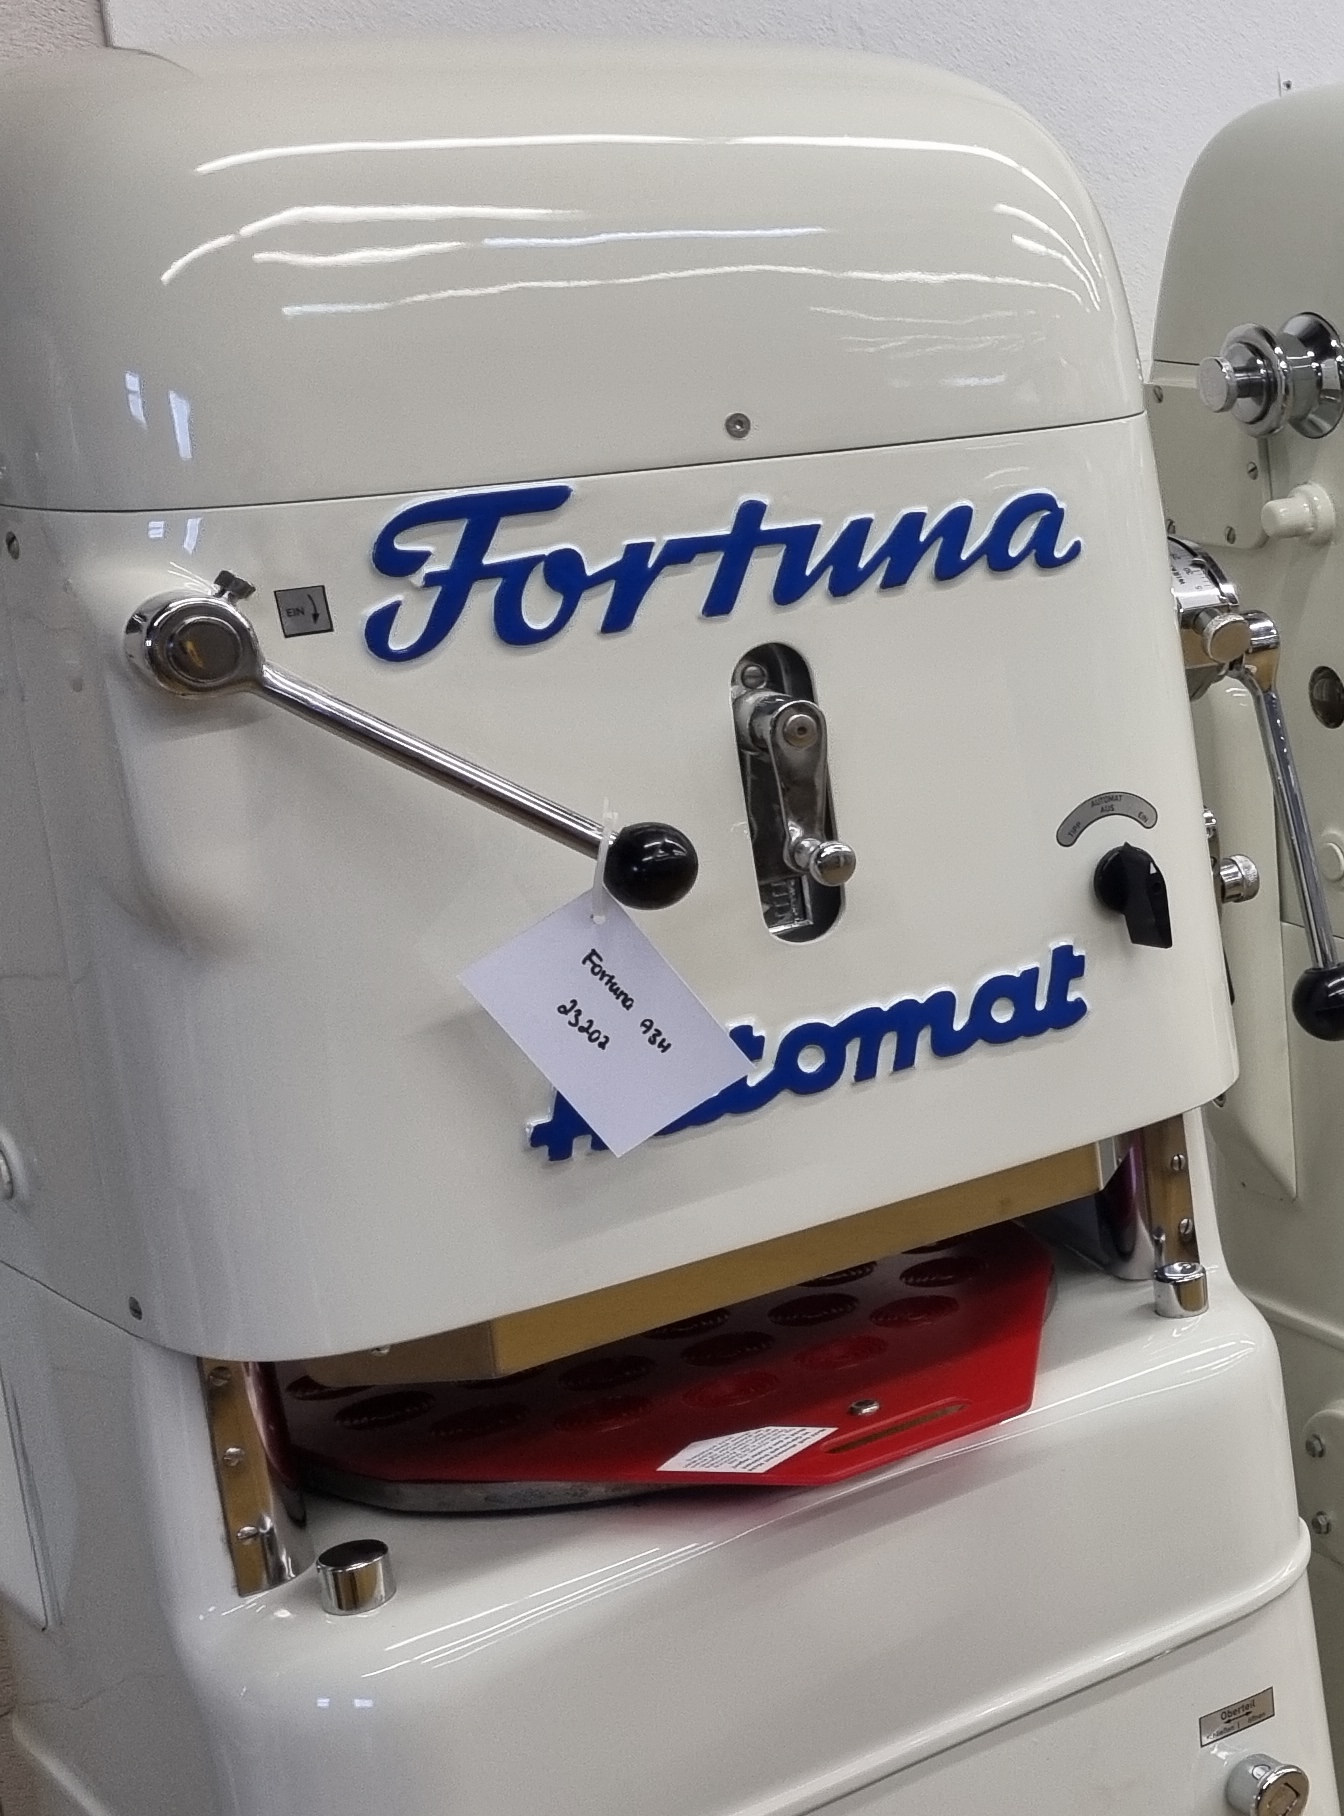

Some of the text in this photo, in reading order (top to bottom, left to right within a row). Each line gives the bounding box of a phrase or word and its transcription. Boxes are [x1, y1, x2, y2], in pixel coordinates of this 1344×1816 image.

[365, 485, 1081, 663] Fortuna
[285, 607, 305, 618] EIN
[1091, 794, 1123, 808] AUTOMAT
[1100, 804, 1115, 813] AUS
[581, 948, 635, 1011] Fortuna
[556, 999, 610, 1050] 23202
[1220, 1699, 1256, 1721] Oberteil
